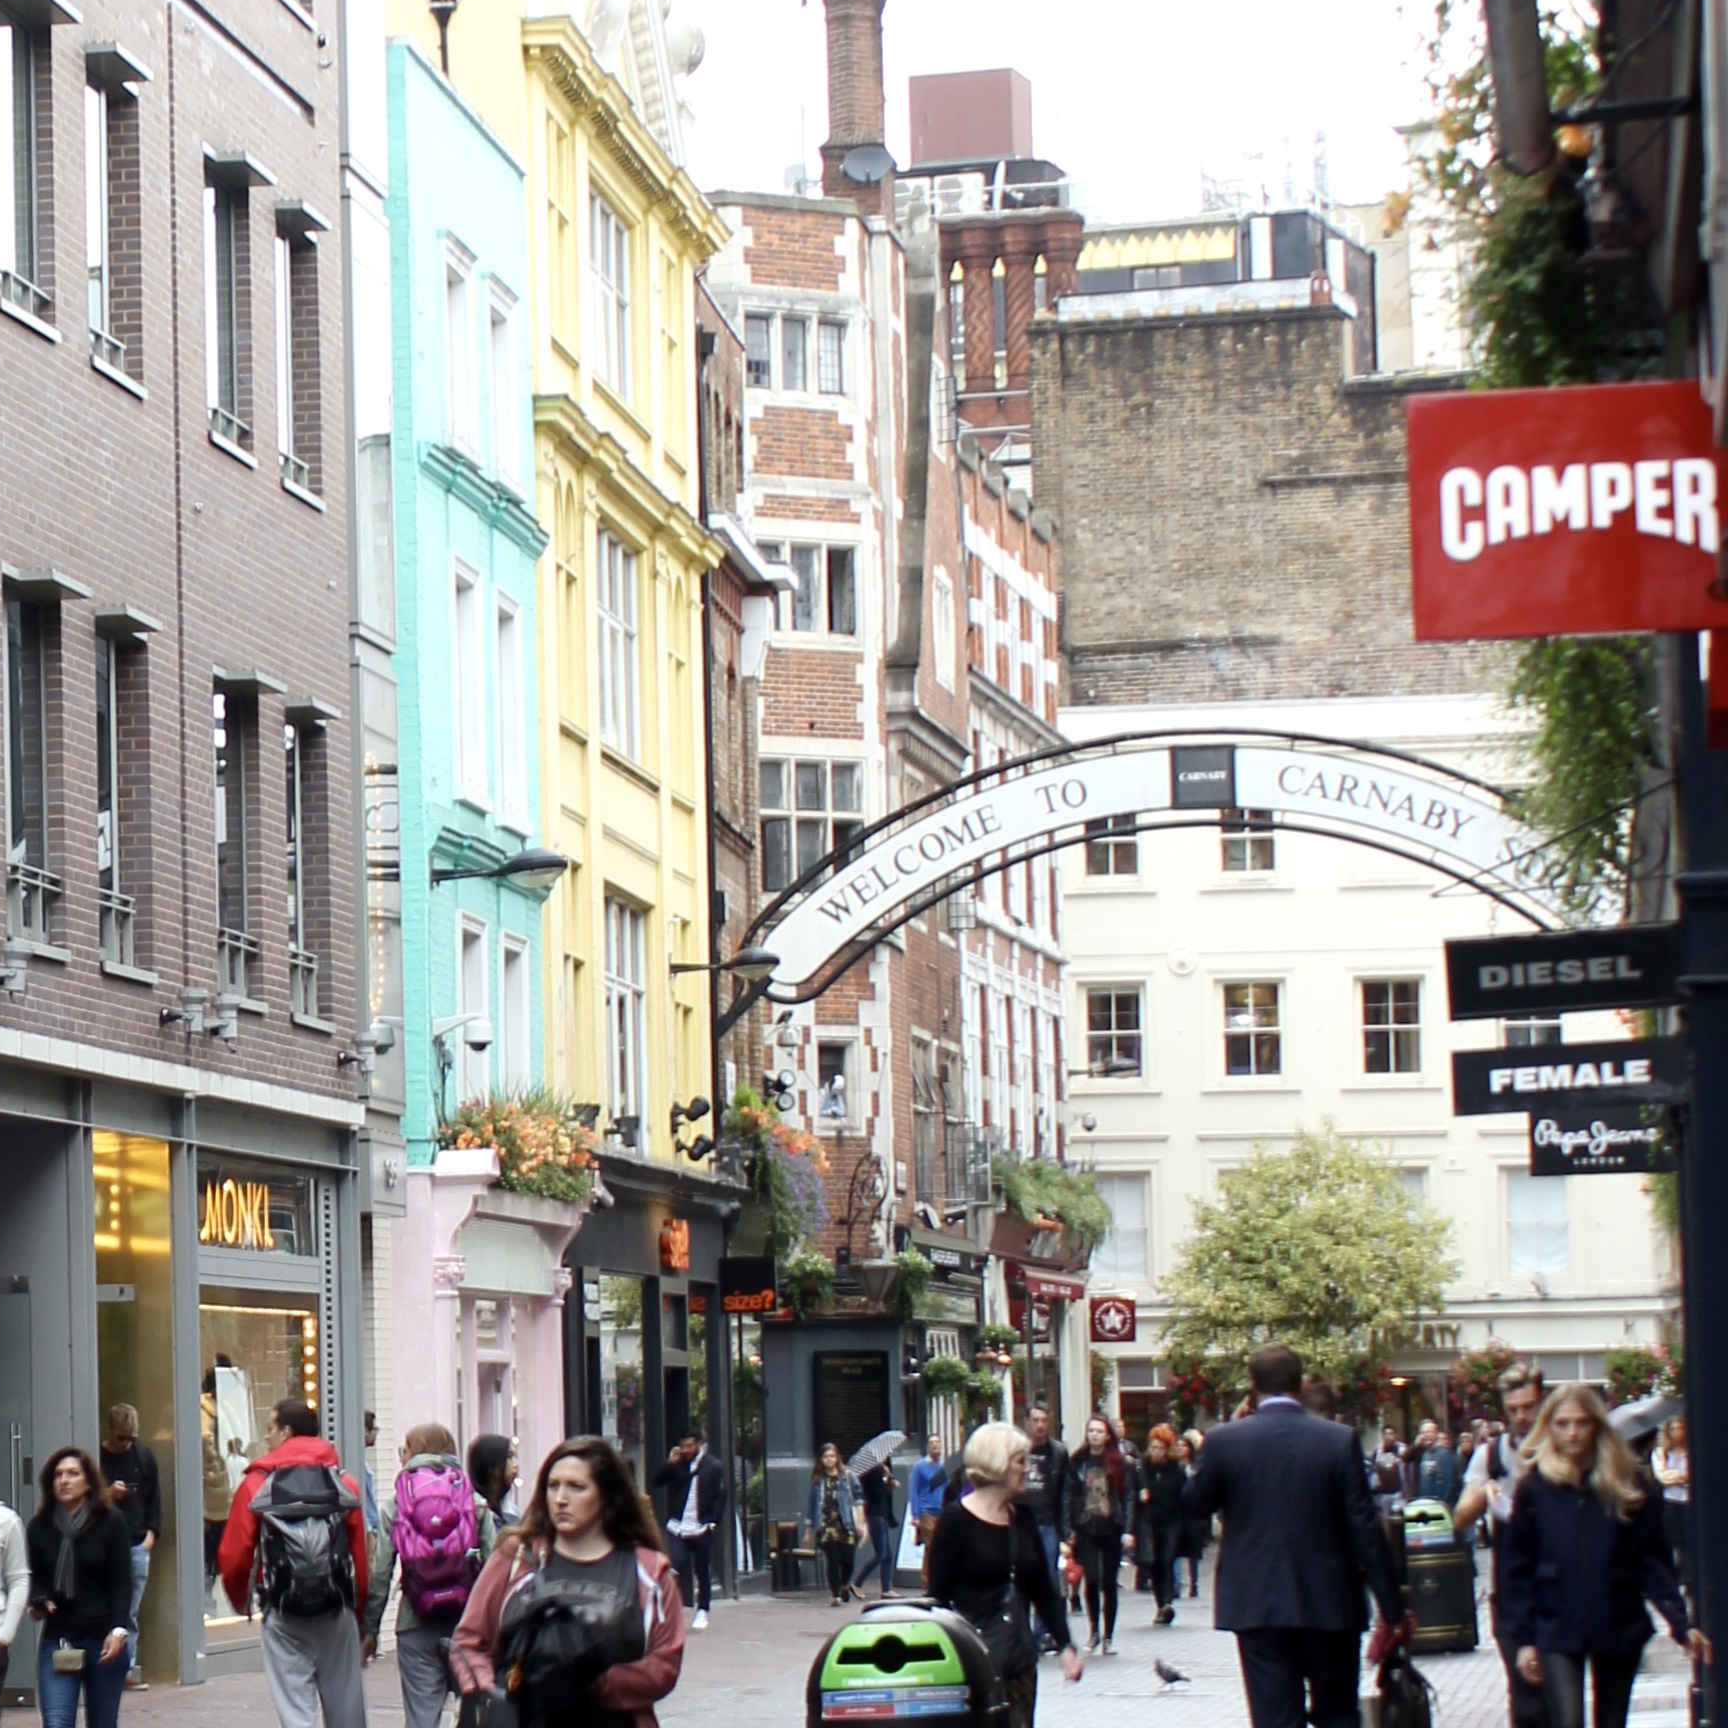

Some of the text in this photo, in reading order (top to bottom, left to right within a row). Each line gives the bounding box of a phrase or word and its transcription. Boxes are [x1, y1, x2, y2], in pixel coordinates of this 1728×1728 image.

[1439, 458, 1720, 562] CAMPER
[816, 804, 1002, 926] WELCOME
[1034, 778, 1088, 815] TO
[1277, 765, 1476, 840] CARNABY
[1478, 956, 1643, 990] DIESEL
[1489, 1059, 1653, 1094] FEMALE
[1533, 1119, 1591, 1155] Pepe
[200, 1177, 275, 1249] MONKI
[724, 1289, 775, 1314] size?
